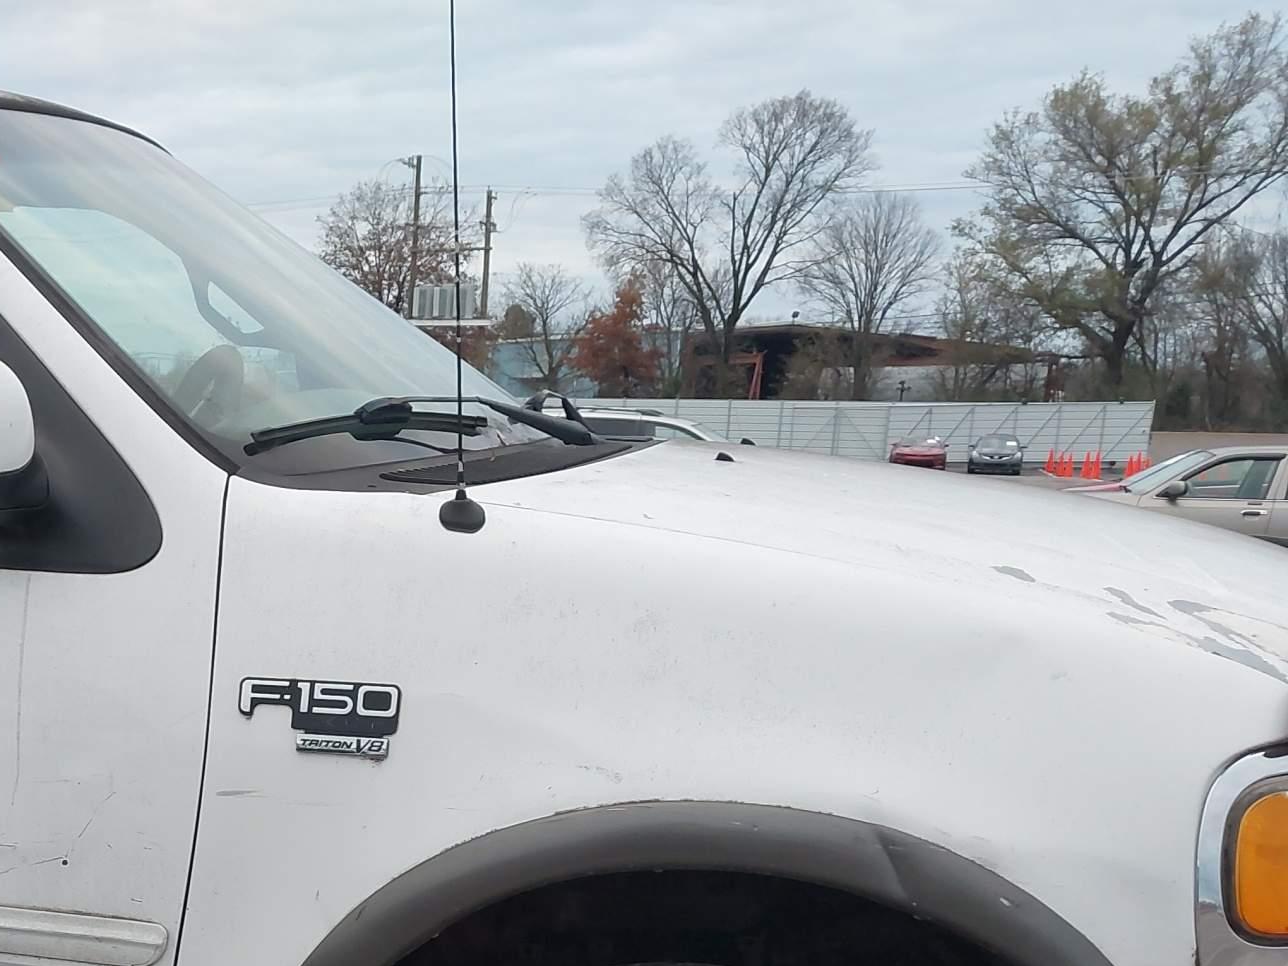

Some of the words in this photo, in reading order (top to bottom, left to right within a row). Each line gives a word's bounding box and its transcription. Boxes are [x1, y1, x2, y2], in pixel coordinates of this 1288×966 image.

[240, 679, 399, 717] F-150
[299, 738, 354, 749] TRITON
[355, 738, 385, 753] V8
